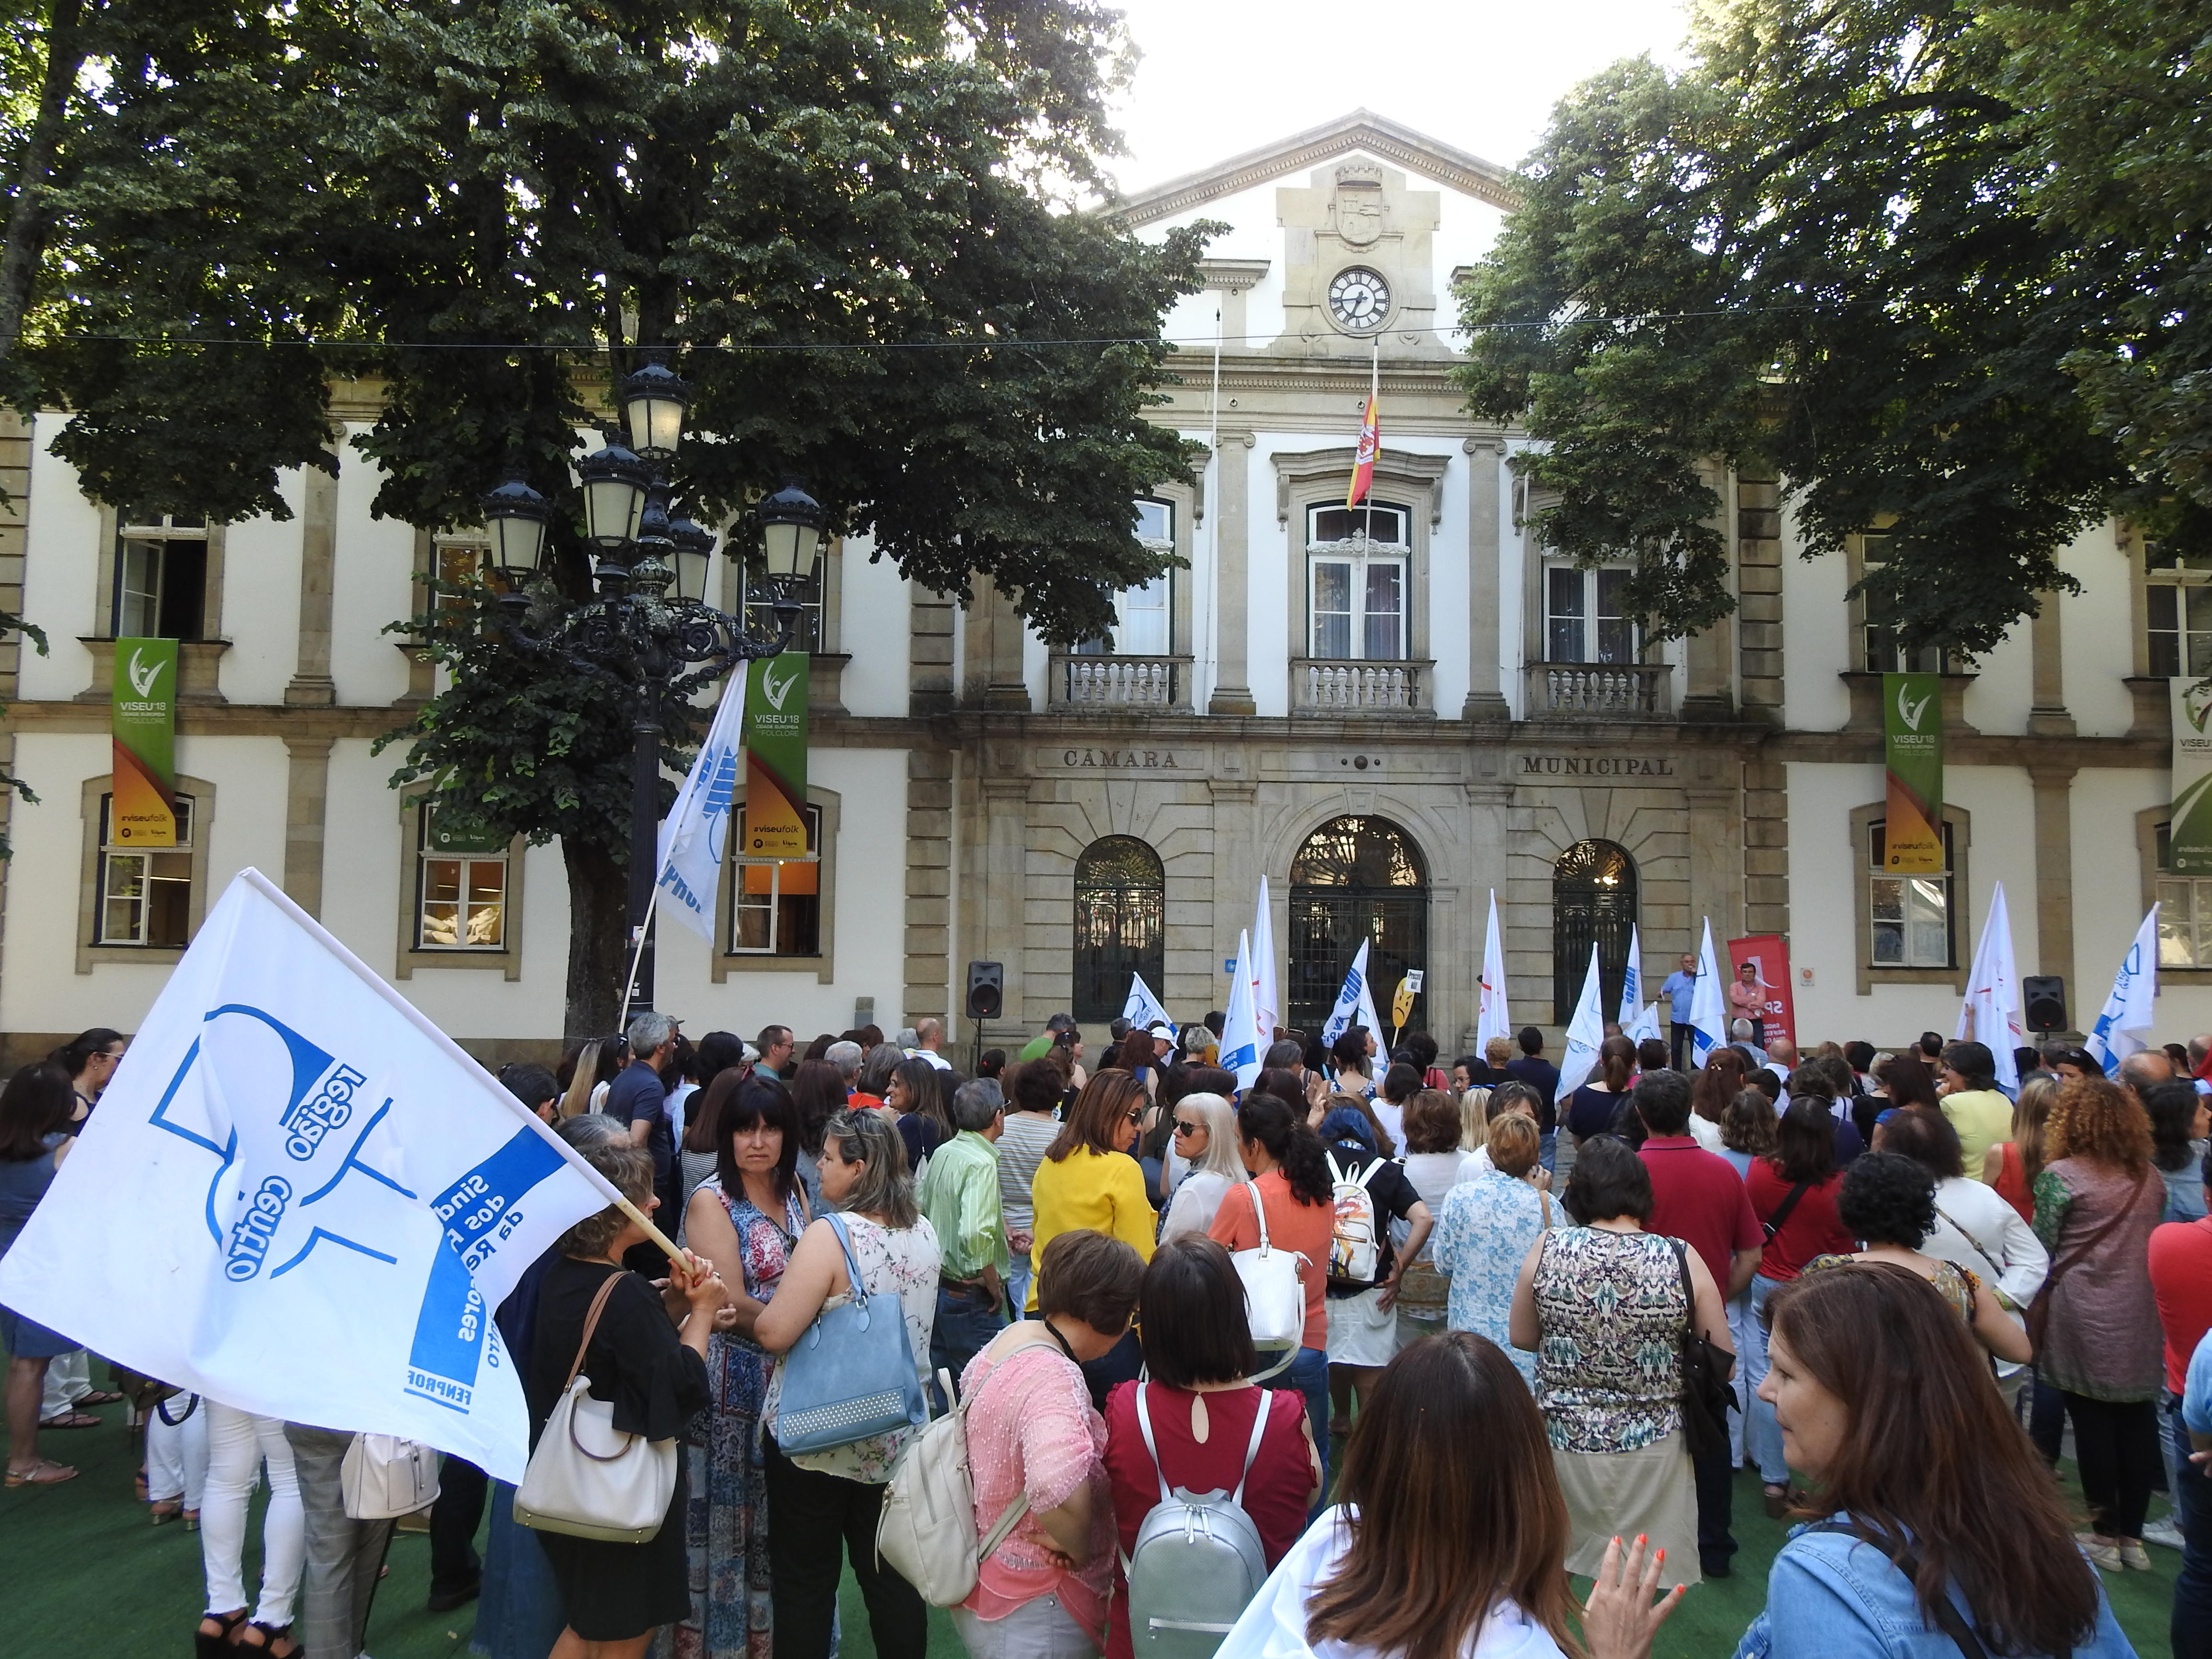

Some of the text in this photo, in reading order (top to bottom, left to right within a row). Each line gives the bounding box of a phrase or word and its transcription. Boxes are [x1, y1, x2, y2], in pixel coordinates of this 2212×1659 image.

[120, 702, 166, 711] VISEU'18
[755, 714, 799, 723] VISEU'18
[1892, 734, 1935, 744] VISEU'18
[2180, 738, 2212, 747] VISEU
[1064, 748, 1673, 776] CÂMARA MUNICIPAL
[754, 825, 799, 833] #viseufolk
